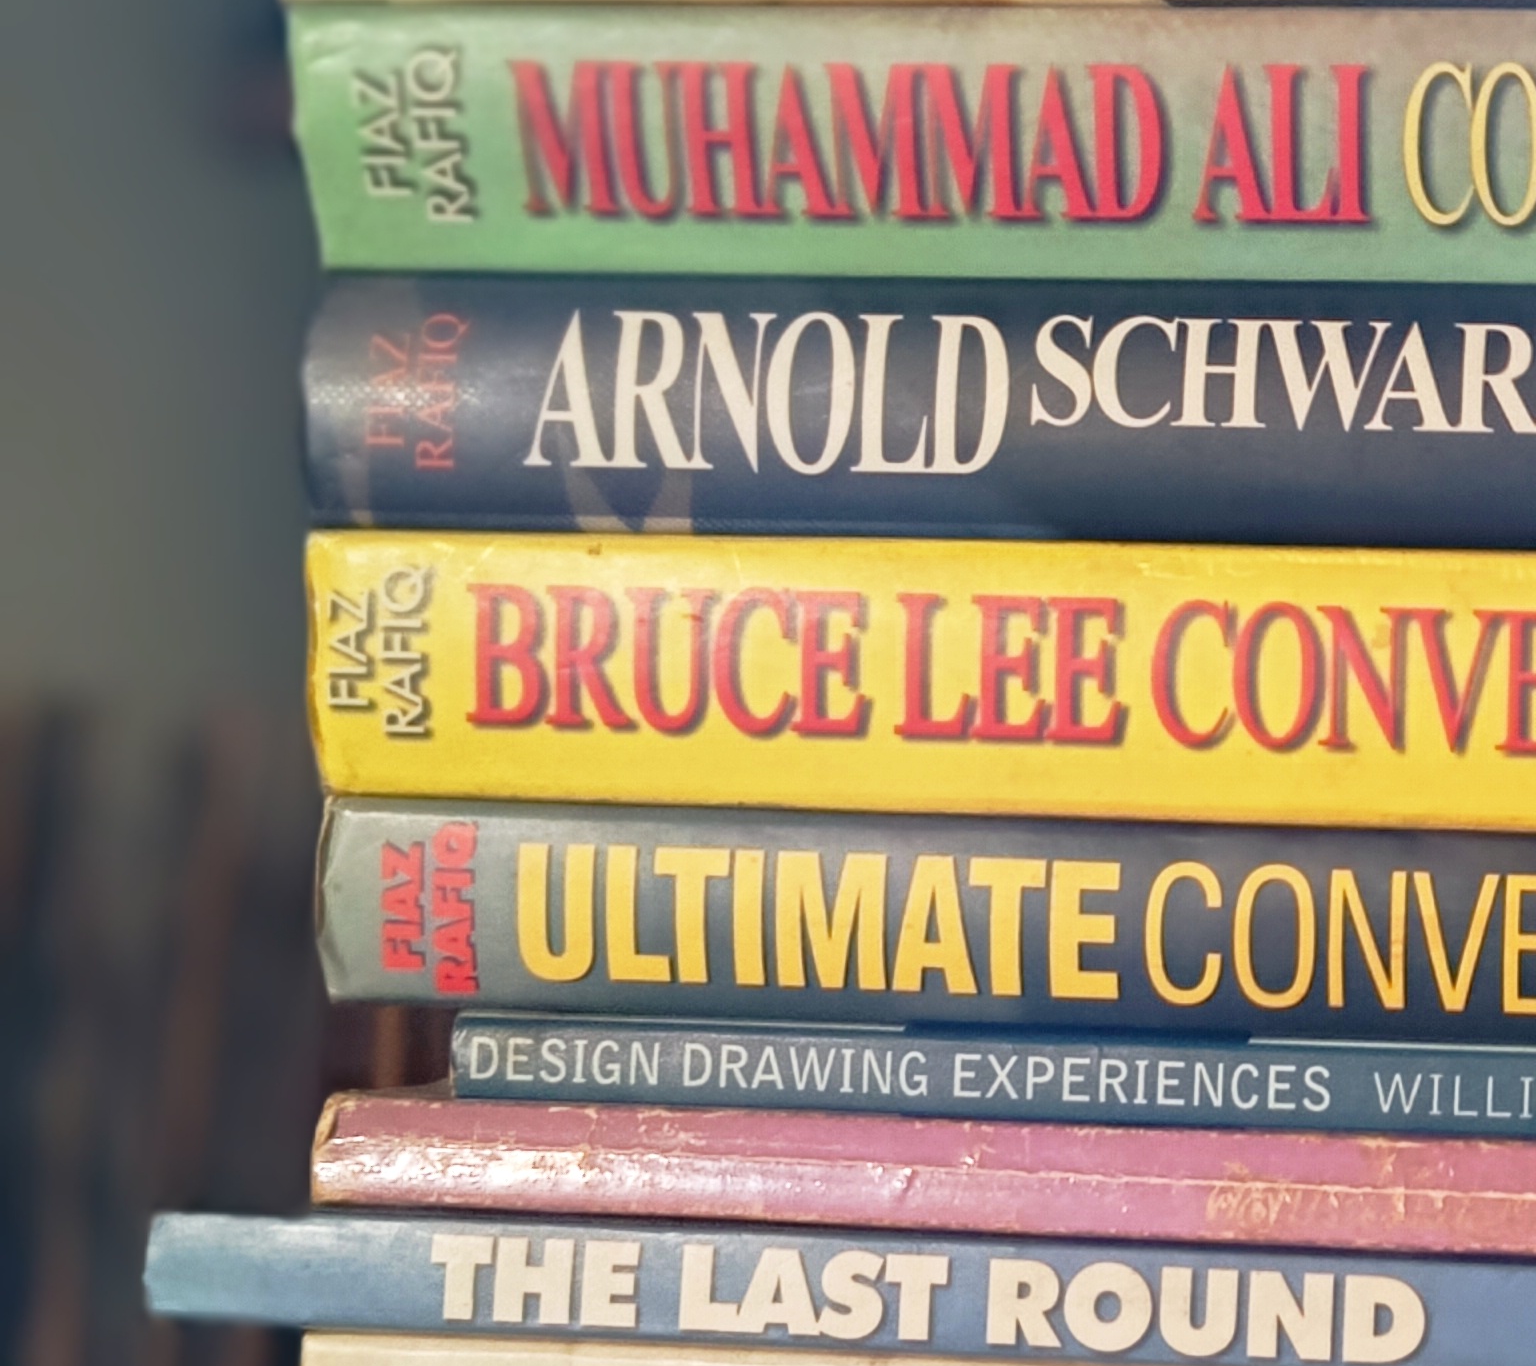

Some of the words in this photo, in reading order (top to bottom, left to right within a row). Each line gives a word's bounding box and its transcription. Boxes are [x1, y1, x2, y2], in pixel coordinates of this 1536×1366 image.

[352, 71, 410, 201] FIAZ
[403, 43, 472, 226] RAFIQ
[506, 60, 1170, 224] MUHAMMAD
[1191, 63, 1372, 225] ALI
[362, 333, 413, 448] FIAZ
[413, 311, 470, 471] RAFIQ
[524, 309, 1010, 476] ARNOLD
[326, 588, 376, 712] FIAZ
[381, 561, 434, 740] RAFIQ
[466, 581, 868, 737] BRUCE
[893, 590, 1126, 745] LEE
[380, 841, 427, 974] FIAZ
[433, 821, 480, 997] RAFIQ
[516, 842, 1121, 1000] ULTIMATE
[468, 1036, 661, 1087] DESIGN
[682, 1041, 928, 1098] DRAWING
[953, 1051, 1331, 1112] EXPERIENCES
[431, 1232, 641, 1329] THE
[678, 1243, 948, 1341] LAST
[985, 1257, 1428, 1365] ROUND
